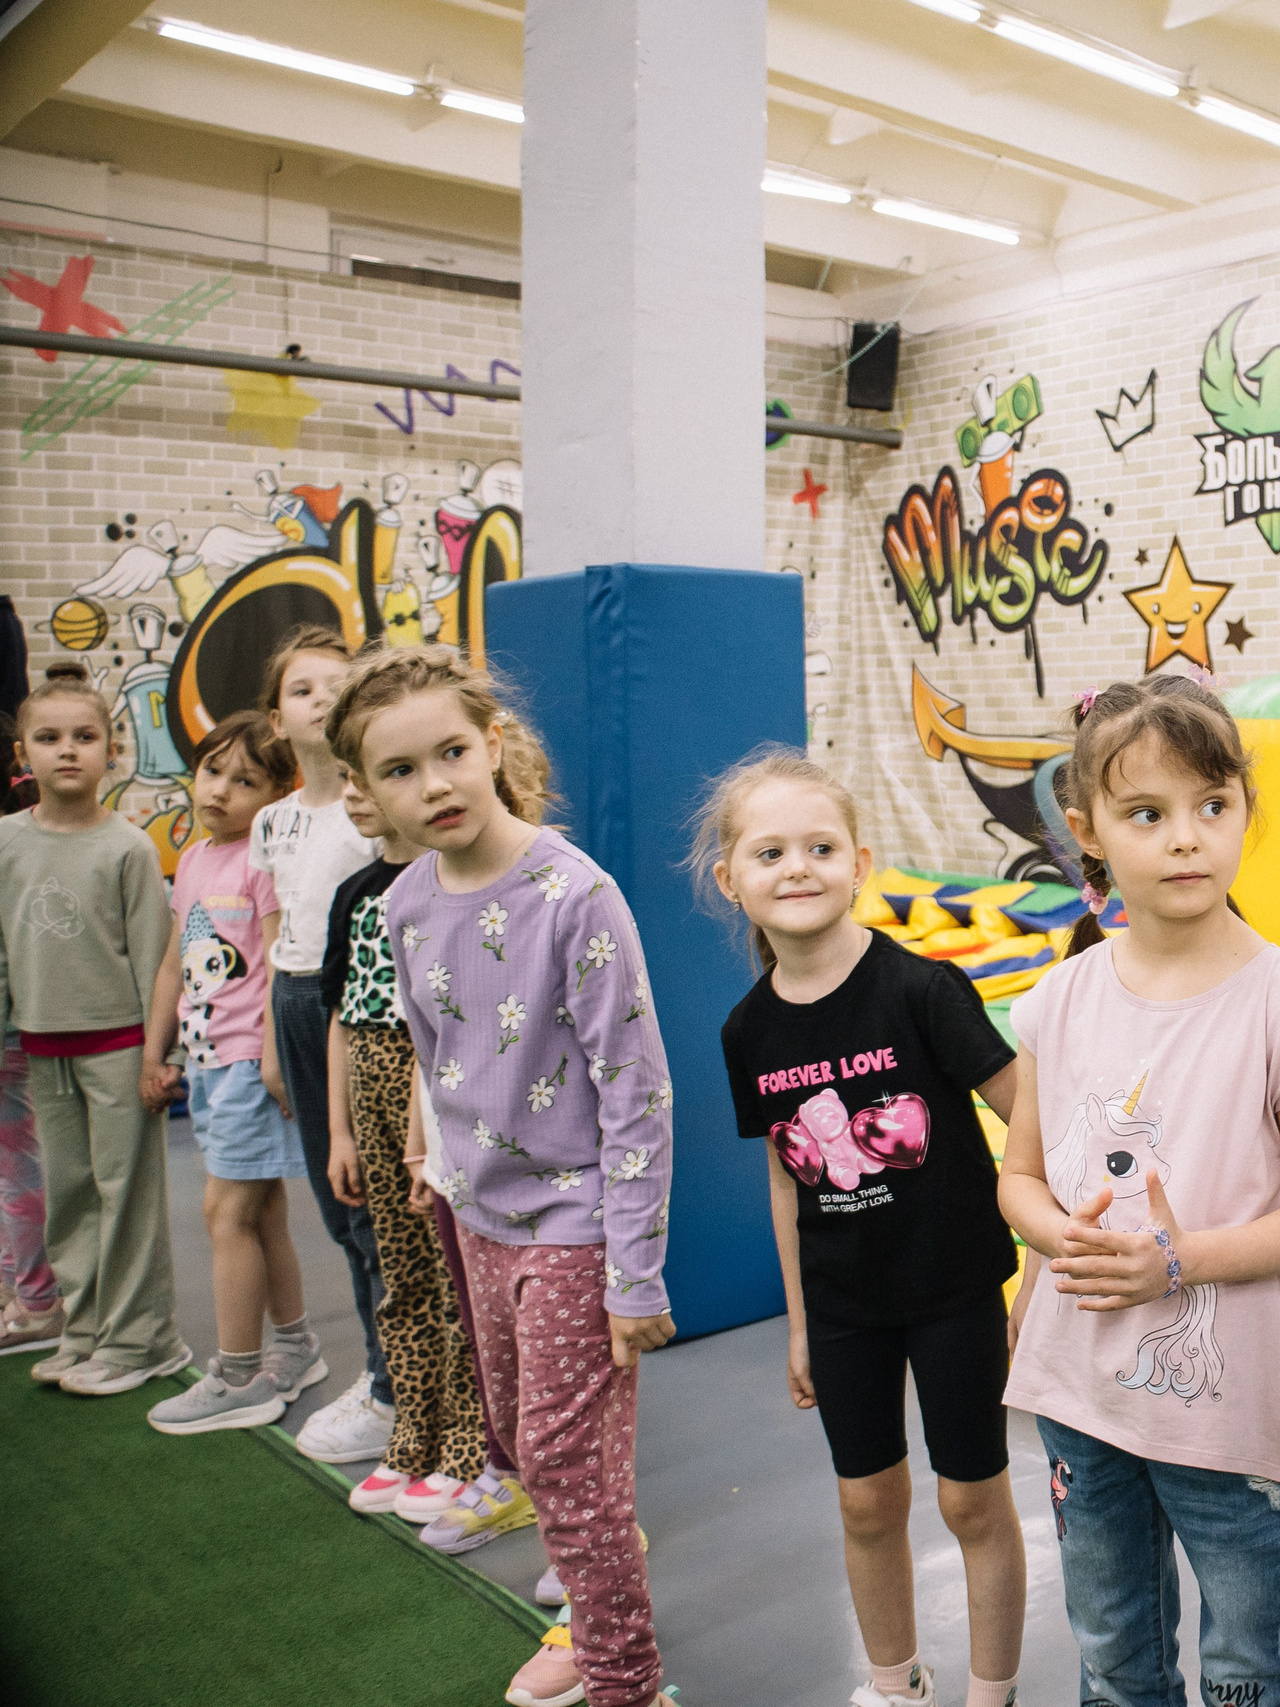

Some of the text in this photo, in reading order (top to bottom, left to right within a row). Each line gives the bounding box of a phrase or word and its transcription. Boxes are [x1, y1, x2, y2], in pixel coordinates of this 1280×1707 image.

[883, 466, 1109, 642] Music
[757, 1047, 898, 1096] FOREVER LOVE
[819, 1184, 889, 1204] DO SMALL THING
[821, 1193, 895, 1213] WITH GREAT LOVE
